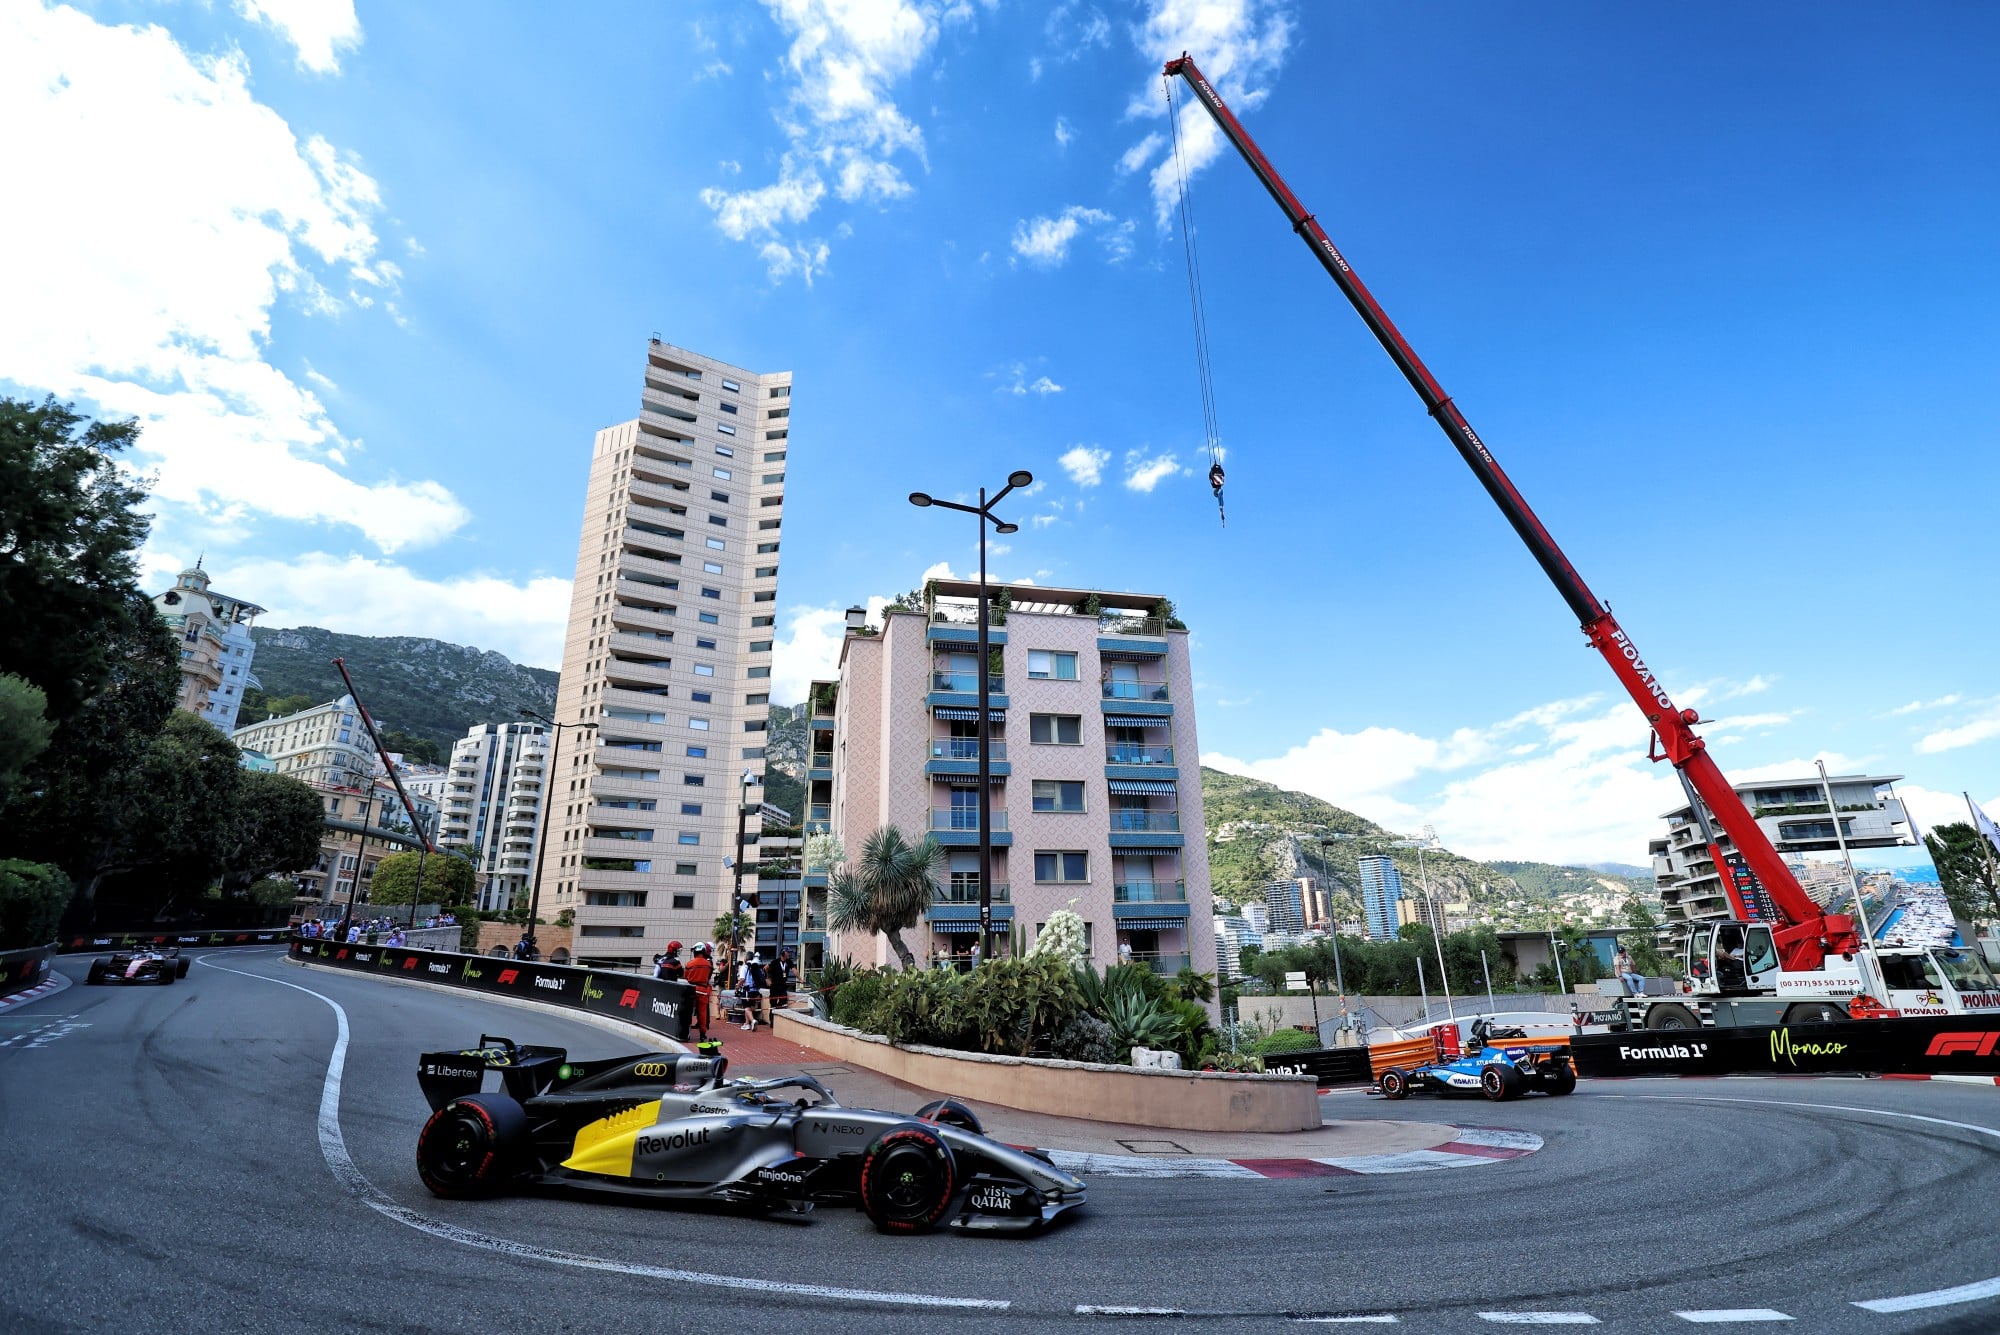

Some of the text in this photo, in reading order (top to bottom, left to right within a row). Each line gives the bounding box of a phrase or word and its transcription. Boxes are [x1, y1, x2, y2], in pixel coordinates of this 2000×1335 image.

[1198, 79, 1223, 108] PIOVANO
[1321, 239, 1350, 272] PIOVANO
[1461, 425, 1493, 463] PIOVANO
[1610, 629, 1672, 709] PIOVANO
[428, 961, 446, 973] Formula
[534, 975, 559, 990] Formula
[651, 997, 671, 1018] Formula
[1780, 980, 1793, 989] (00
[1794, 980, 1811, 988] 377)
[1903, 1007, 1949, 1015] PIOVANO
[1619, 1044, 1690, 1060] Formula
[1770, 1027, 1848, 1067] Monaco
[437, 1064, 478, 1078] Libertex
[573, 1066, 585, 1076] bp
[698, 1104, 730, 1115] Castrol
[832, 1125, 865, 1136] NEXO
[638, 1127, 711, 1156] Revolut
[758, 1169, 802, 1183] ninjaOne
[971, 1194, 1012, 1210] QATAR
